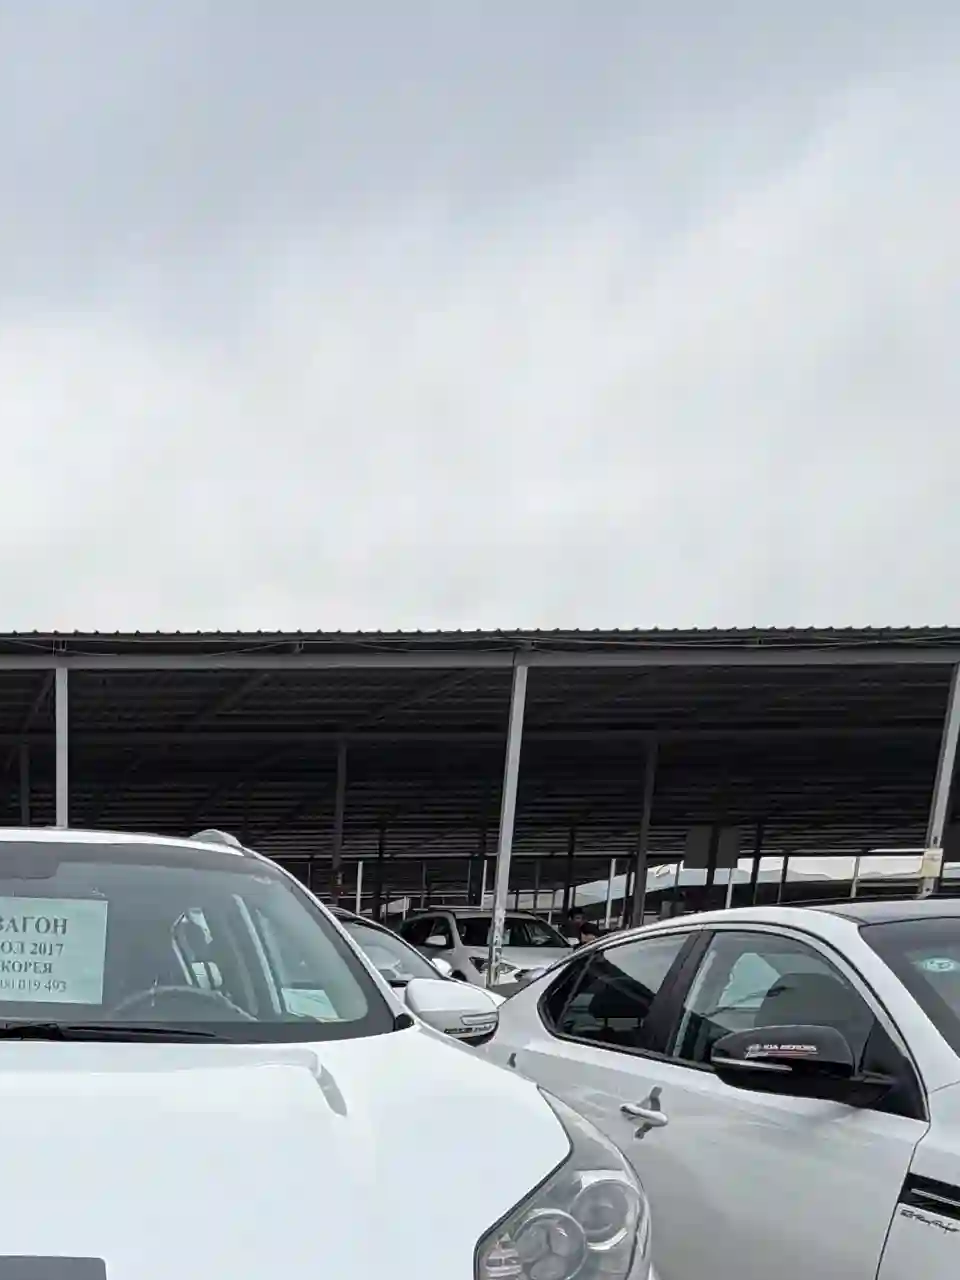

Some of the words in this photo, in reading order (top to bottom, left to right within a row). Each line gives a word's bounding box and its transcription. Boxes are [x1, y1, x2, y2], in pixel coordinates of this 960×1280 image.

[30, 942, 64, 957] 2017
[0, 959, 53, 975] КОРЕЯ
[44, 979, 67, 993] 493
